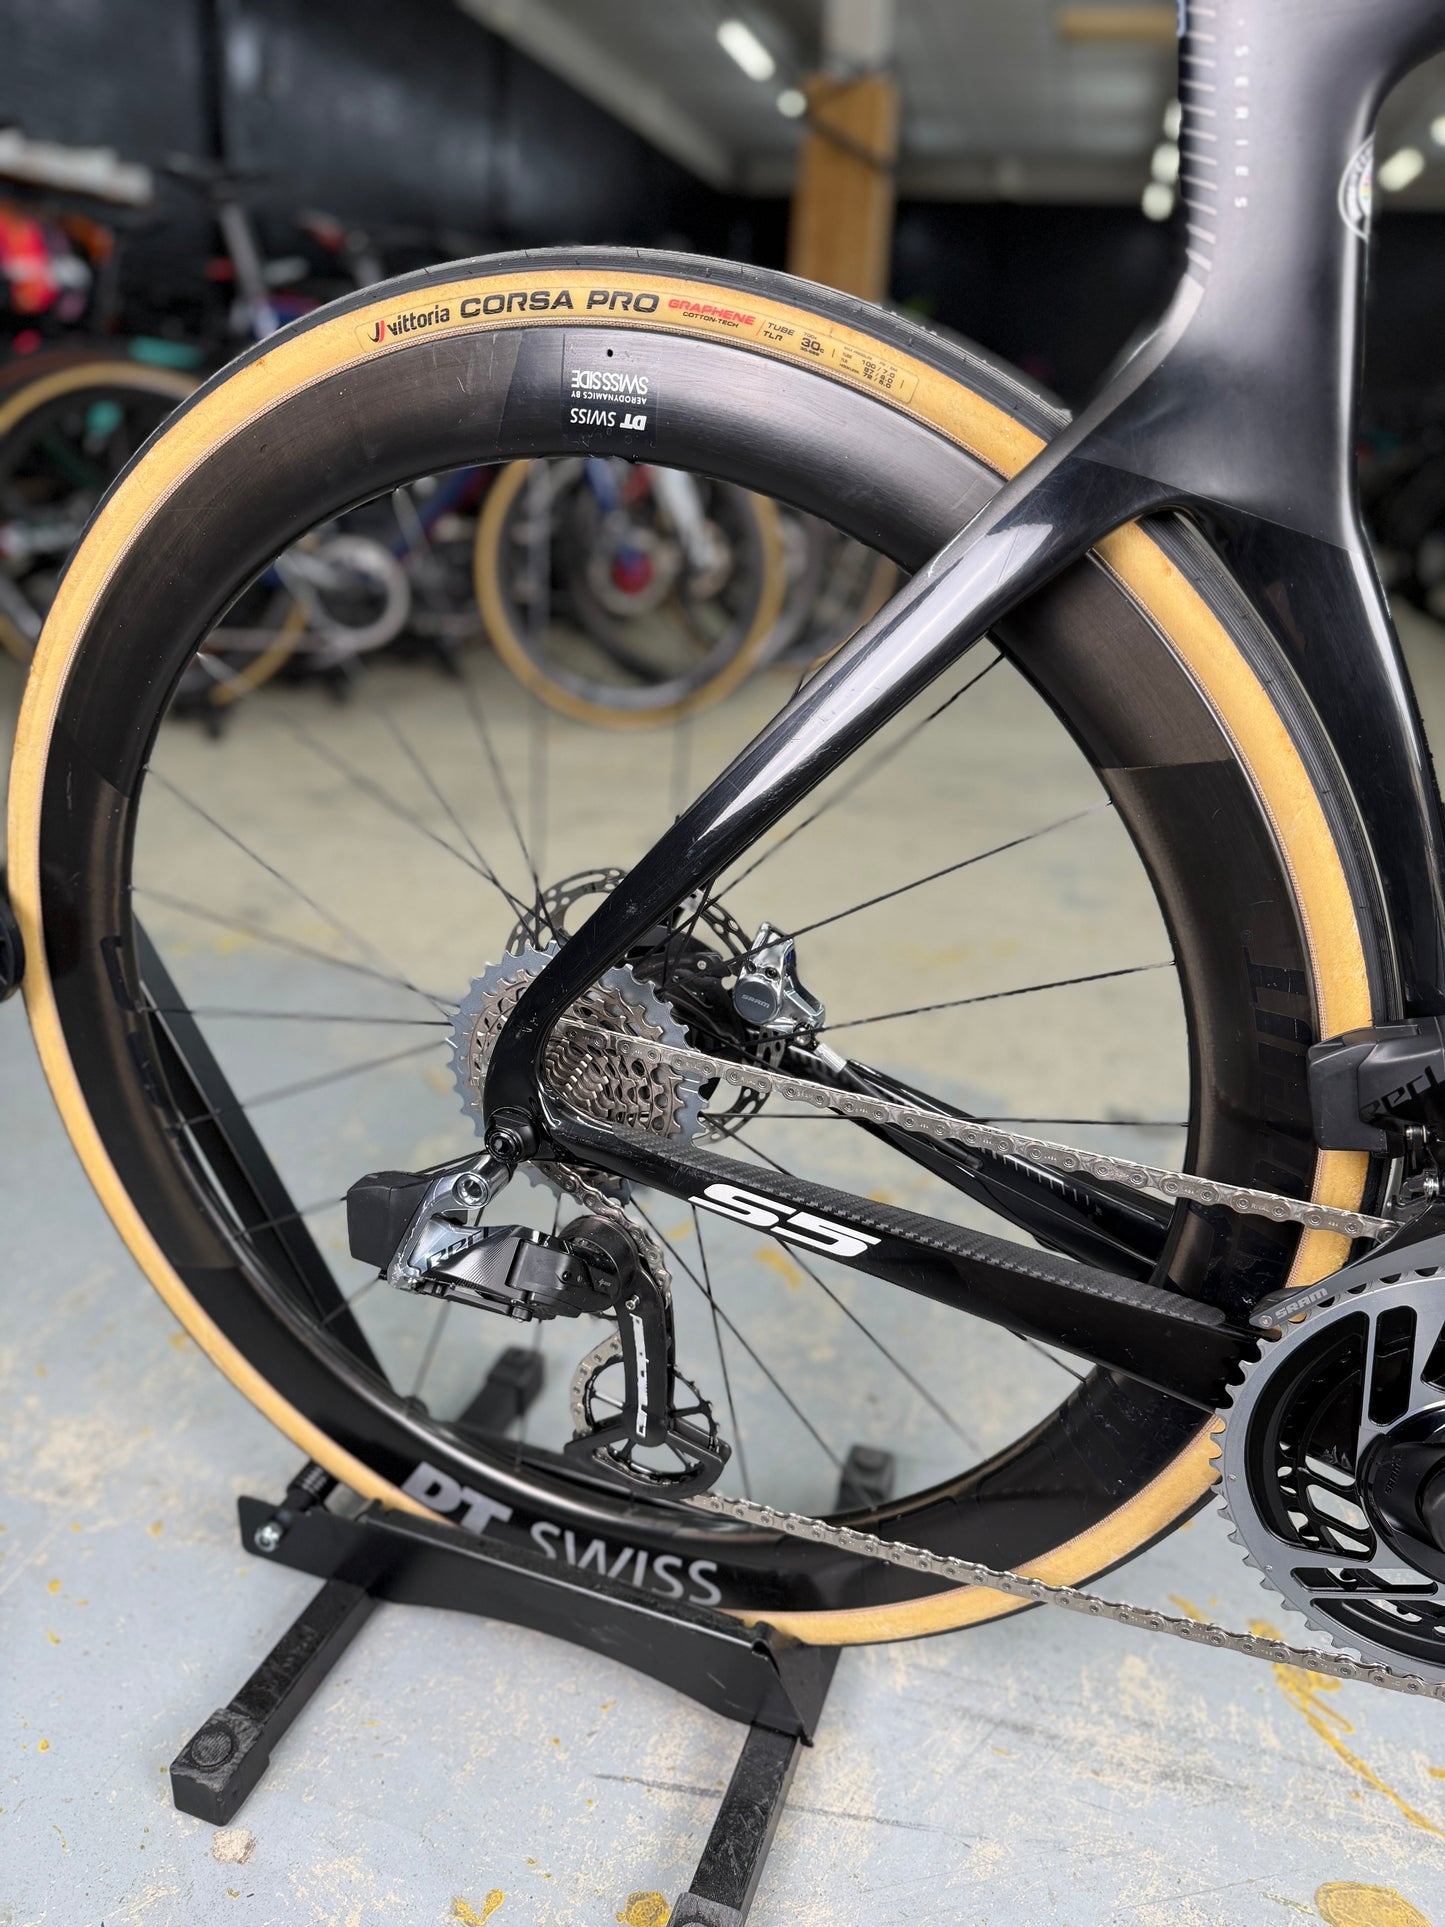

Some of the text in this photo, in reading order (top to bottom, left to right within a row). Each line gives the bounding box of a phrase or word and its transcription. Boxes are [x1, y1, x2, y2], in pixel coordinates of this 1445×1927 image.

[460, 290, 660, 319] CORSA PRO
[667, 298, 757, 326] GRAPHENE
[386, 304, 450, 336] vittoria
[682, 311, 739, 328] COTTON-TECH
[767, 321, 796, 336] TUBE
[763, 330, 783, 341] TLR
[861, 359, 877, 370] 100
[570, 390, 648, 405] AERODYNAMICS BY
[569, 407, 647, 431] DT SWISS
[741, 993, 770, 1009] SRAM
[687, 1183, 882, 1257] S5
[1274, 1287, 1328, 1320] SRAM
[400, 1460, 722, 1607] DT SWISS
